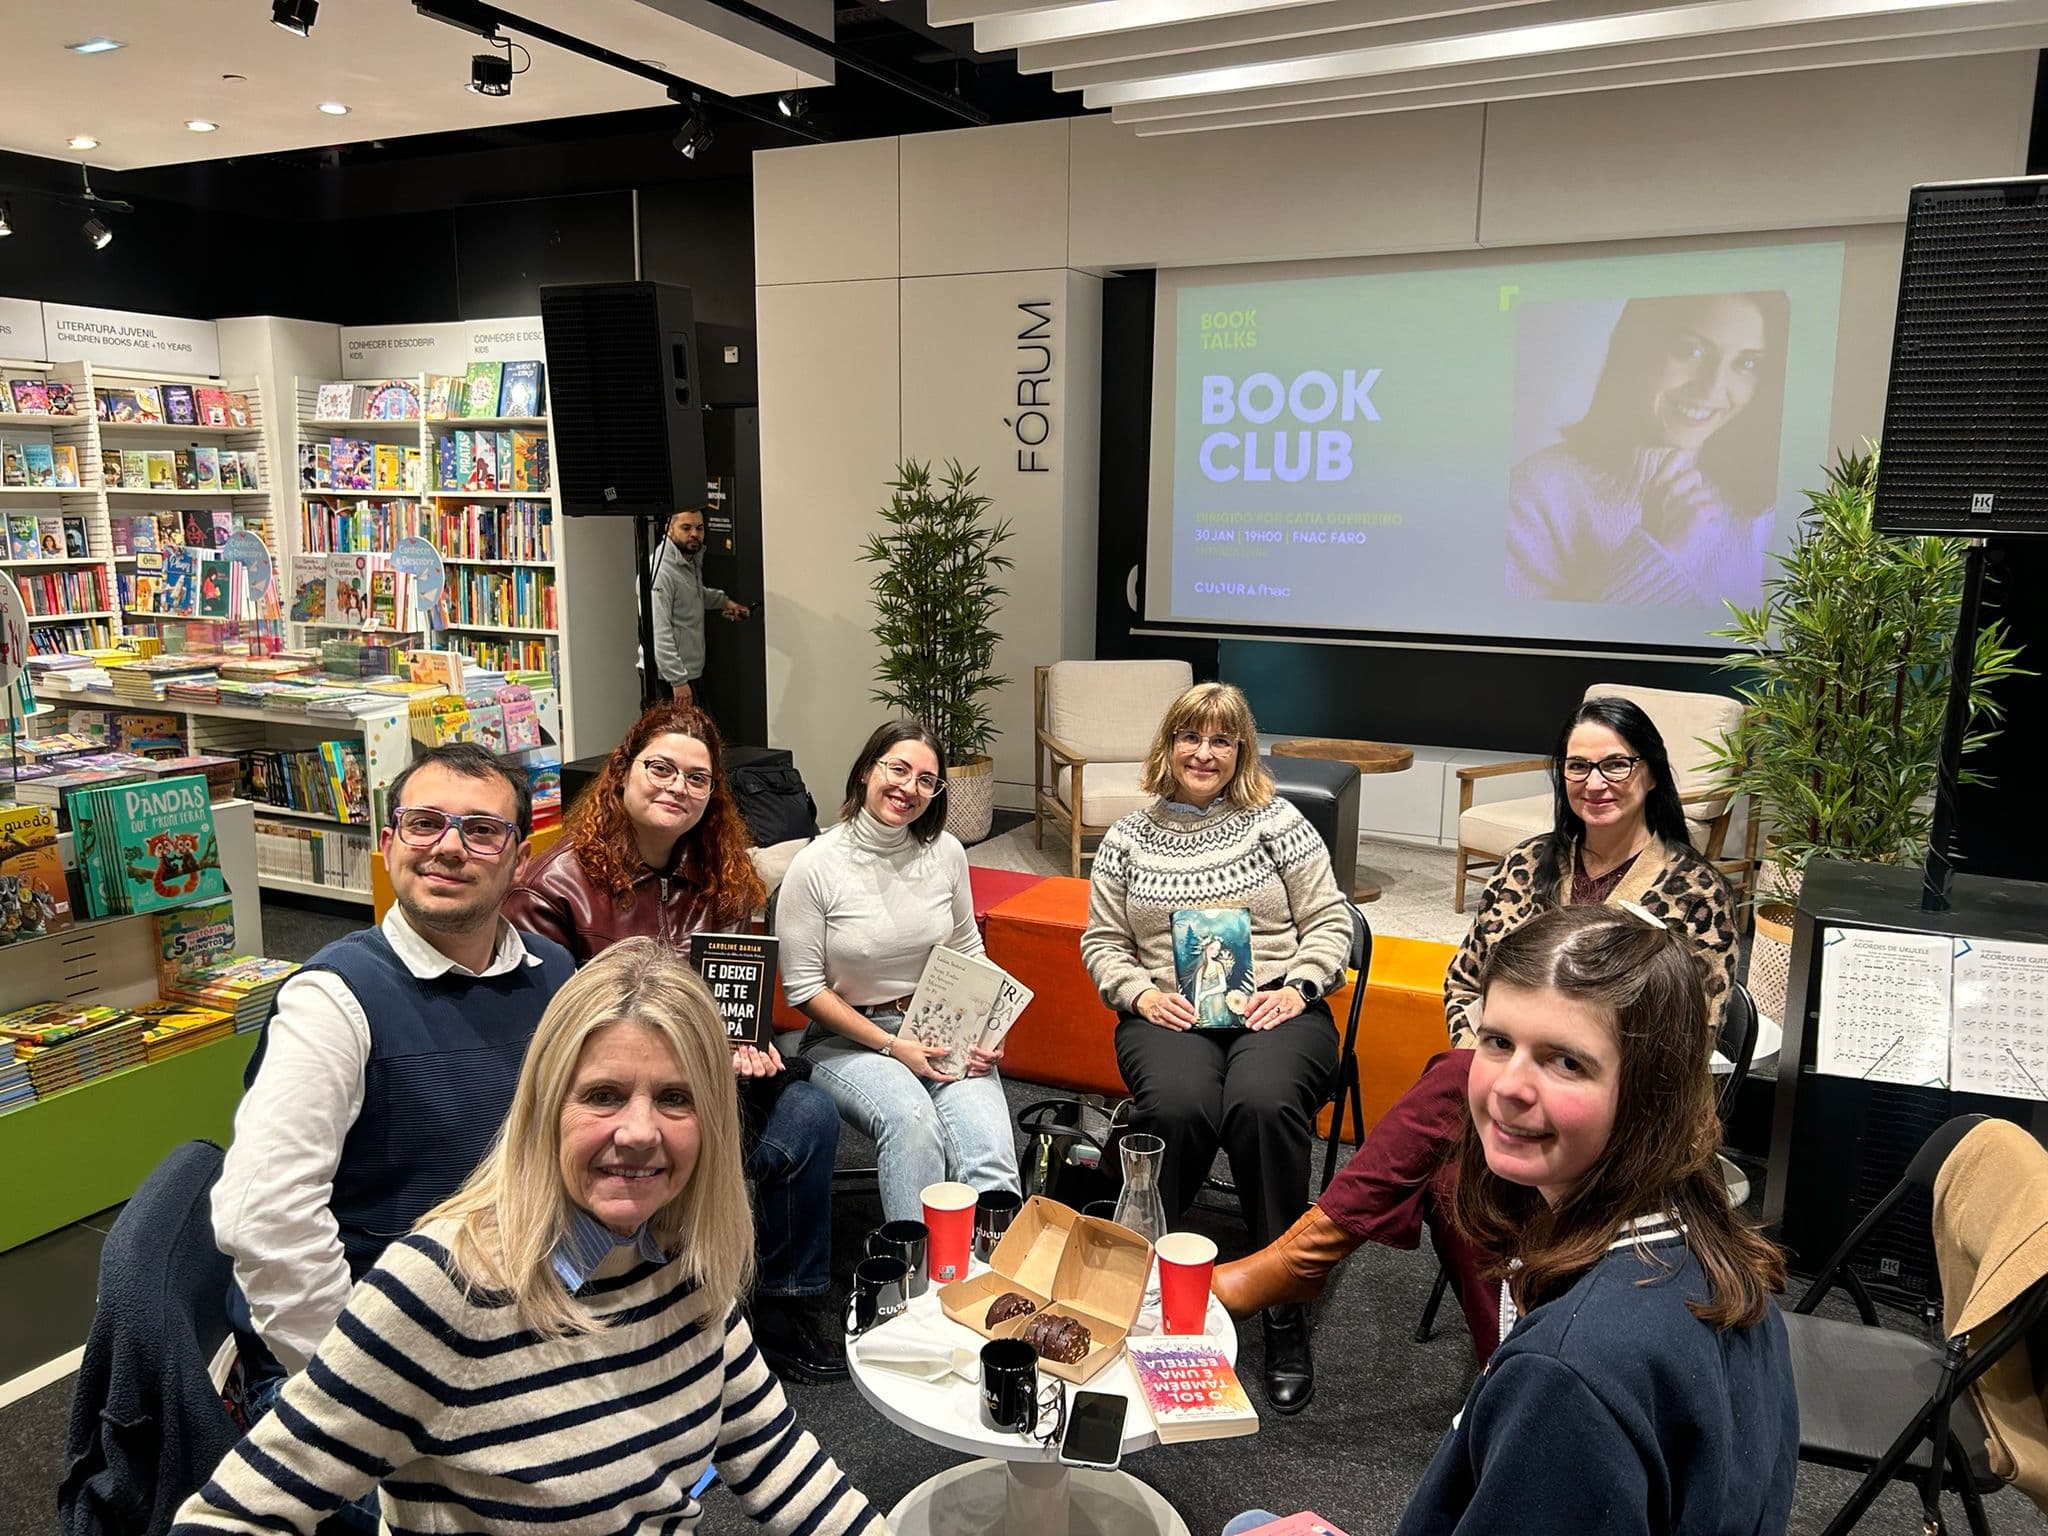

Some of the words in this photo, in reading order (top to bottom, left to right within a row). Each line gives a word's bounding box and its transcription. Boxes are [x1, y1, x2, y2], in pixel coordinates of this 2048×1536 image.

[1200, 309, 1257, 331] BOOK
[57, 320, 116, 335] LITERATURA
[118, 327, 158, 339] JUVENIL
[57, 333, 101, 344] CHILDREN
[102, 337, 132, 347] BOOKS
[133, 340, 150, 349] AGE
[152, 342, 166, 350] +10
[167, 343, 192, 352] YEARS
[349, 340, 387, 350] CONHECER
[387, 339, 393, 348] E
[394, 338, 435, 348] DESCOBRIR
[474, 332, 515, 344] CONHECER
[517, 331, 522, 341] E
[1200, 330, 1258, 350] TALKS
[350, 352, 363, 360] KIDS
[474, 345, 490, 354] KIDS
[1002, 301, 1051, 473] FÓRUM
[1200, 368, 1383, 425] BOOK
[459, 433, 473, 475] PIRATAS
[1199, 430, 1354, 483] CLUB
[1974, 496, 1991, 507] HK
[1244, 531, 1282, 543] 19H00
[1292, 531, 1327, 543] FNAC
[1330, 532, 1367, 545] FARO
[1257, 584, 1291, 597] fnac
[125, 785, 205, 820] PANDAS
[131, 820, 149, 834] QUE
[174, 935, 187, 955] 5
[708, 942, 737, 951] CAROLINE
[1852, 942, 1887, 951] ACORDES
[1887, 944, 1898, 952] DE
[1899, 945, 1930, 955] UKULELE
[1980, 953, 2015, 962] ACORDES
[708, 964, 717, 979] E
[719, 965, 757, 981] DEIXEI
[714, 983, 731, 998] DE
[733, 984, 748, 999] TE
[1143, 1357, 1219, 1370] ESTRELA
[1158, 1369, 1201, 1380] UMA
[1153, 1379, 1230, 1393] TAMBÉM
[1168, 1391, 1205, 1403] SOL
[1207, 1391, 1223, 1400] O
